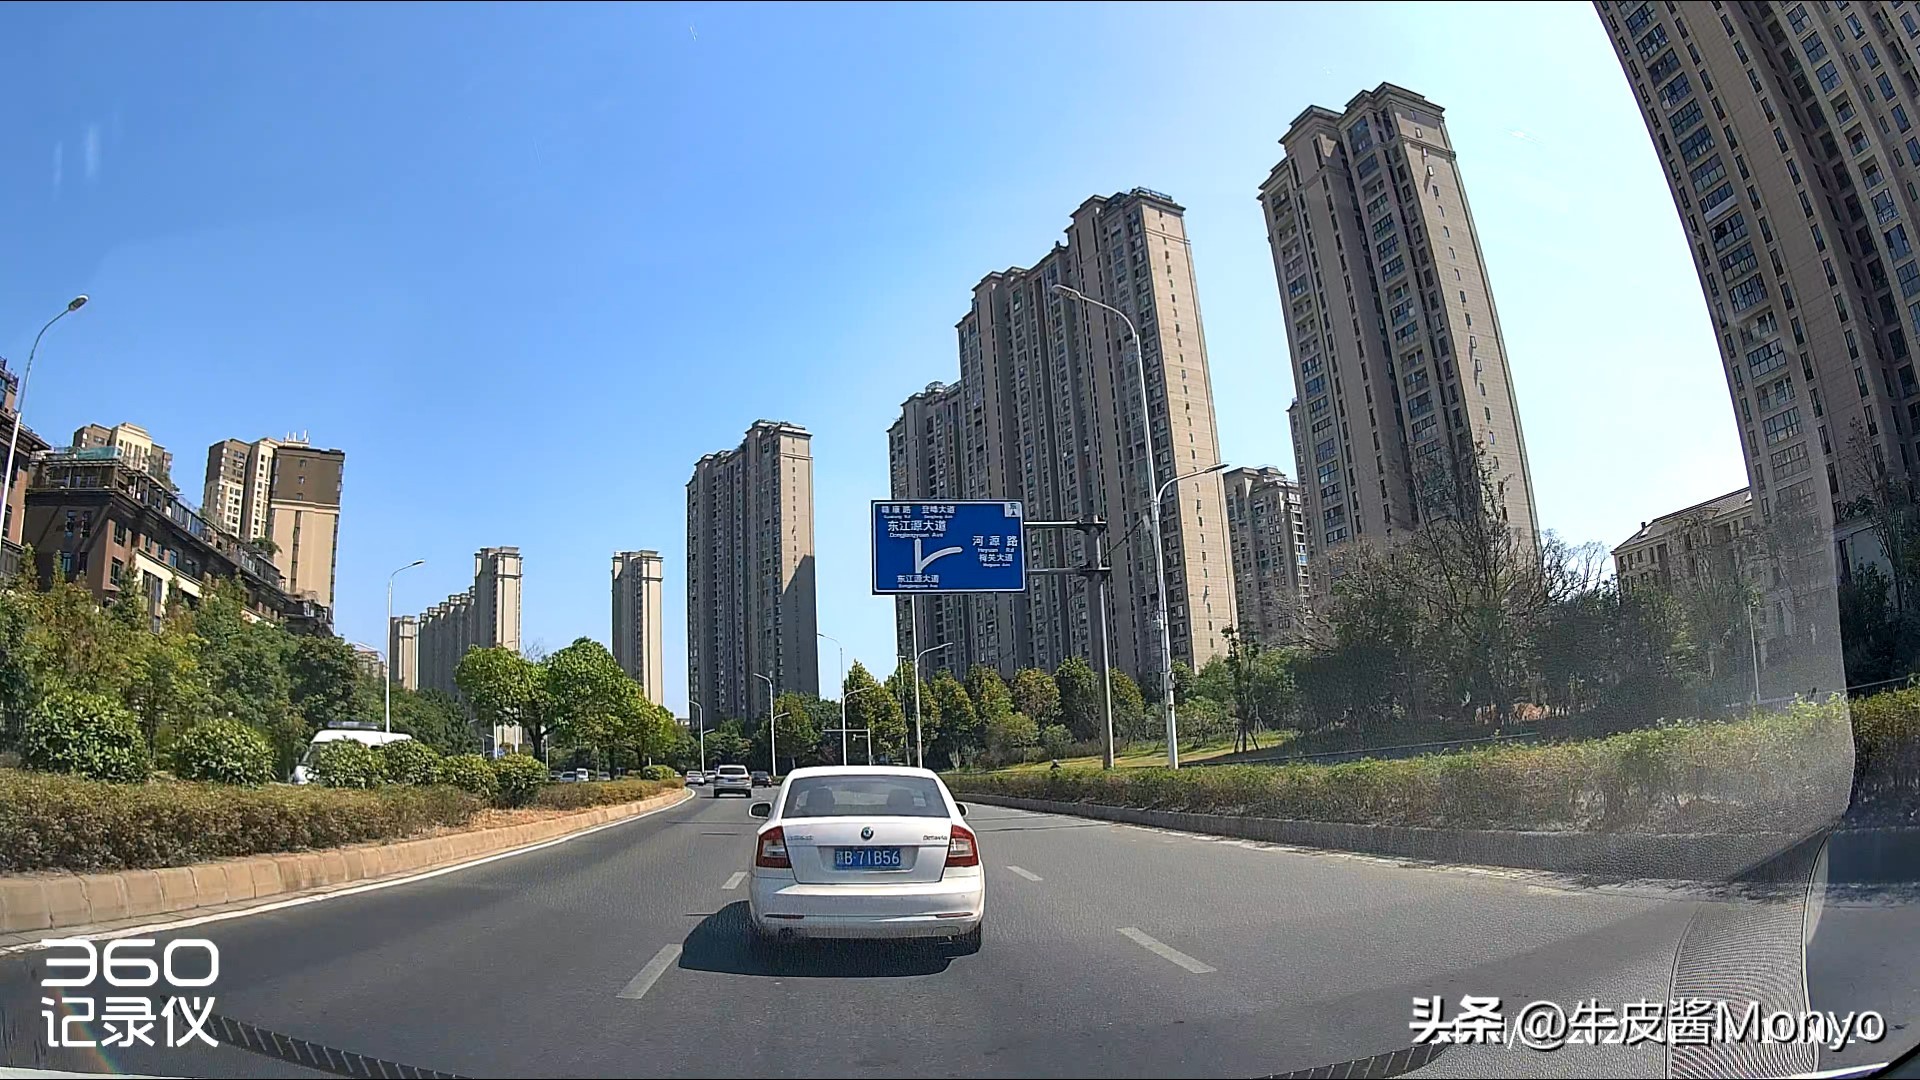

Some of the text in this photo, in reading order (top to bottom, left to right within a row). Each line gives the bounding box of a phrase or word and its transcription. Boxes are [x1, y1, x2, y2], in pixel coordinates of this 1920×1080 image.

[887, 520, 947, 531] 东江源大道
[972, 535, 1019, 547] 河源路
